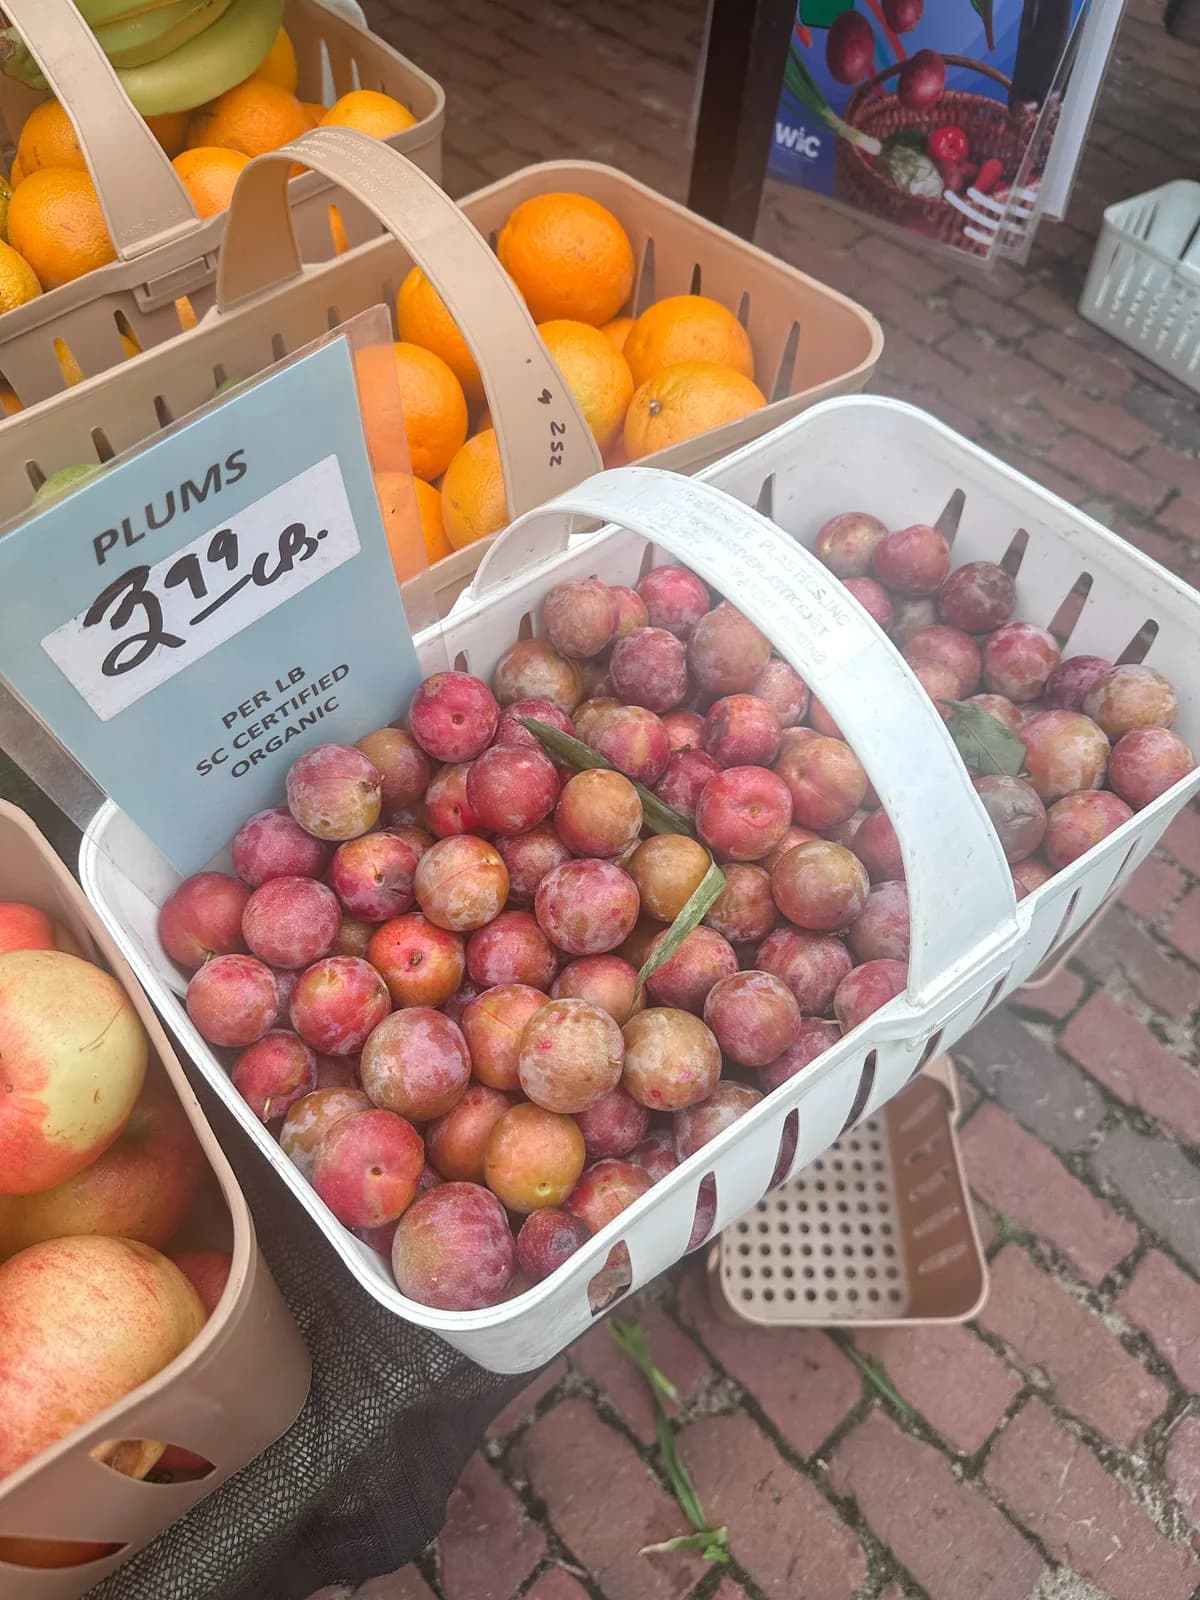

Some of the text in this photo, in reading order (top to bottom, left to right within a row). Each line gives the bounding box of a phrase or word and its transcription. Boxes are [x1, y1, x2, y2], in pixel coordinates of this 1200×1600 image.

[92, 448, 248, 566] PLUMS
[195, 663, 351, 778] SC CERTIFIED
[221, 666, 306, 730] PER LB
[230, 696, 341, 780] ORGANIC
